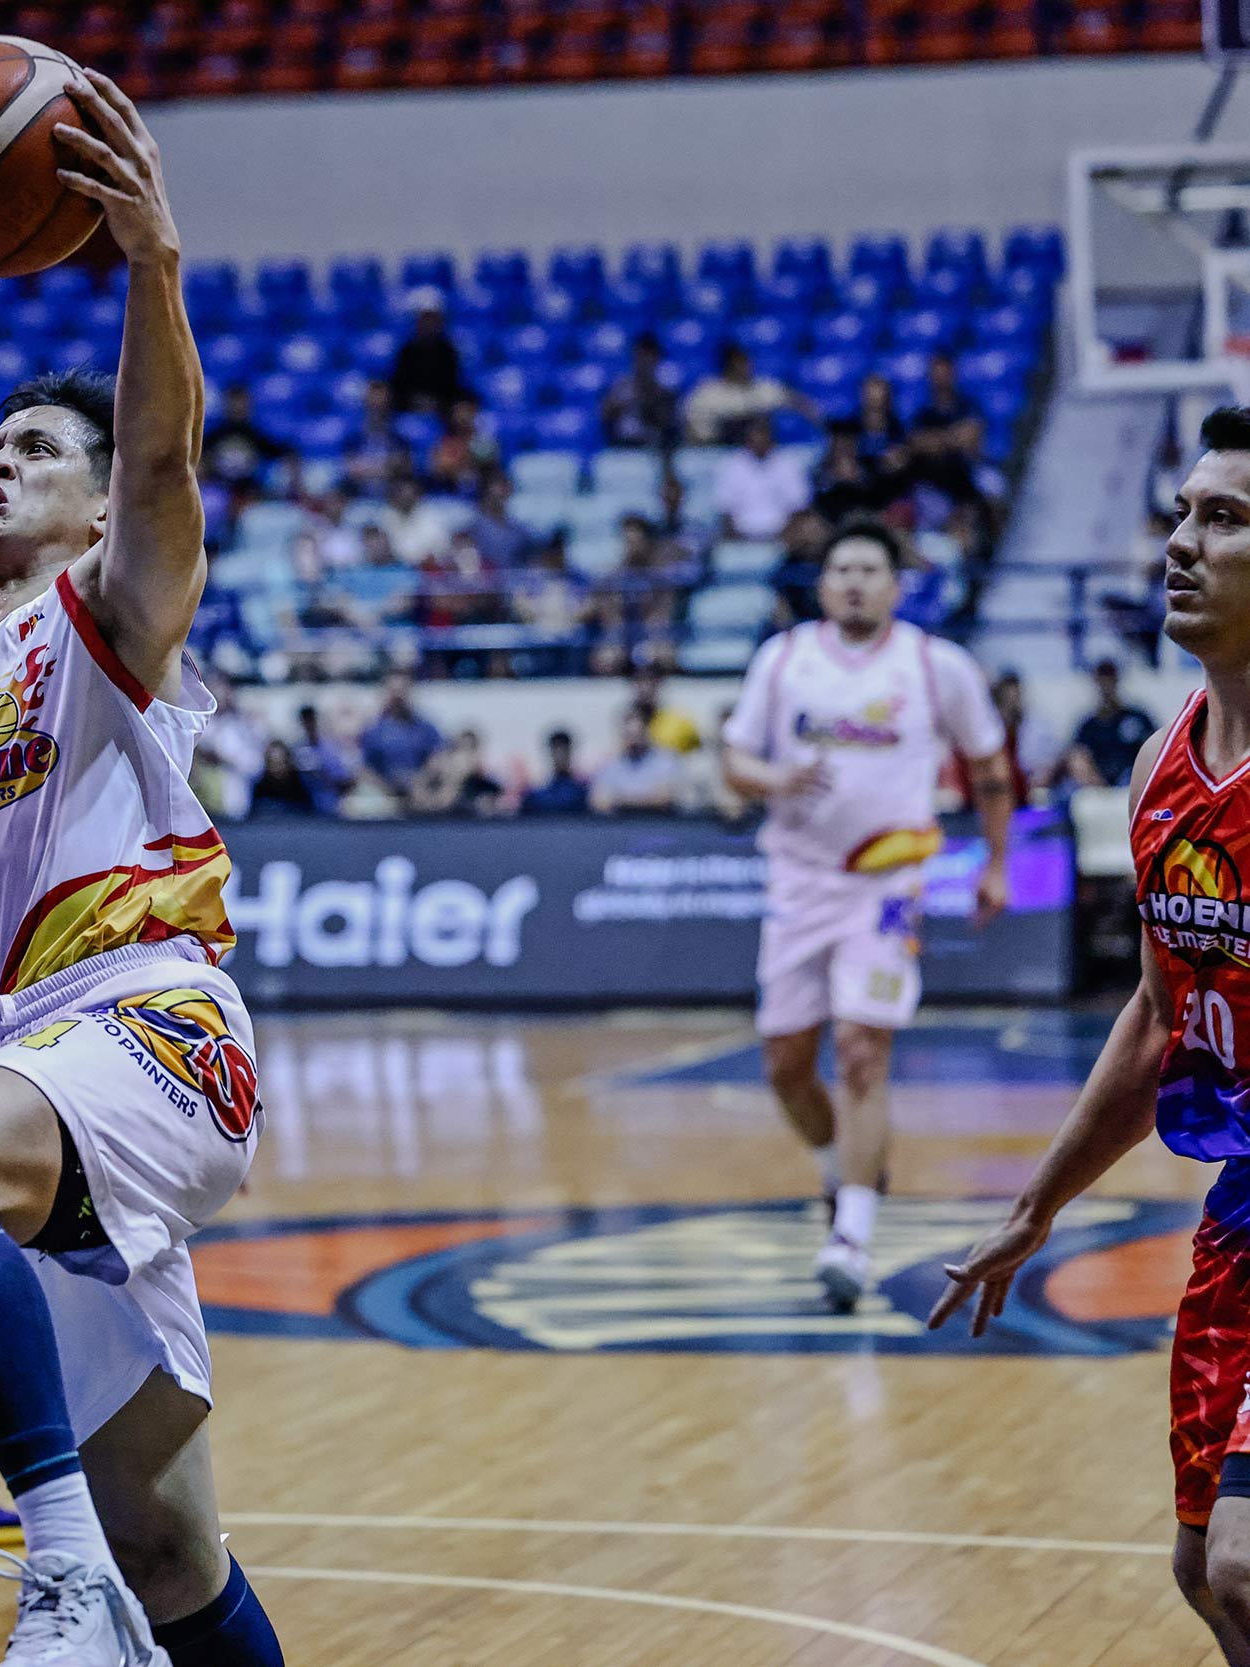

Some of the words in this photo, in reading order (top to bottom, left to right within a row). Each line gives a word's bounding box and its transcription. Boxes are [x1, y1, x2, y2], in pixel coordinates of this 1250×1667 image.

[222, 854, 540, 968] Haier
[1182, 988, 1237, 1070] 20
[117, 1036, 199, 1119] PAINTERS
